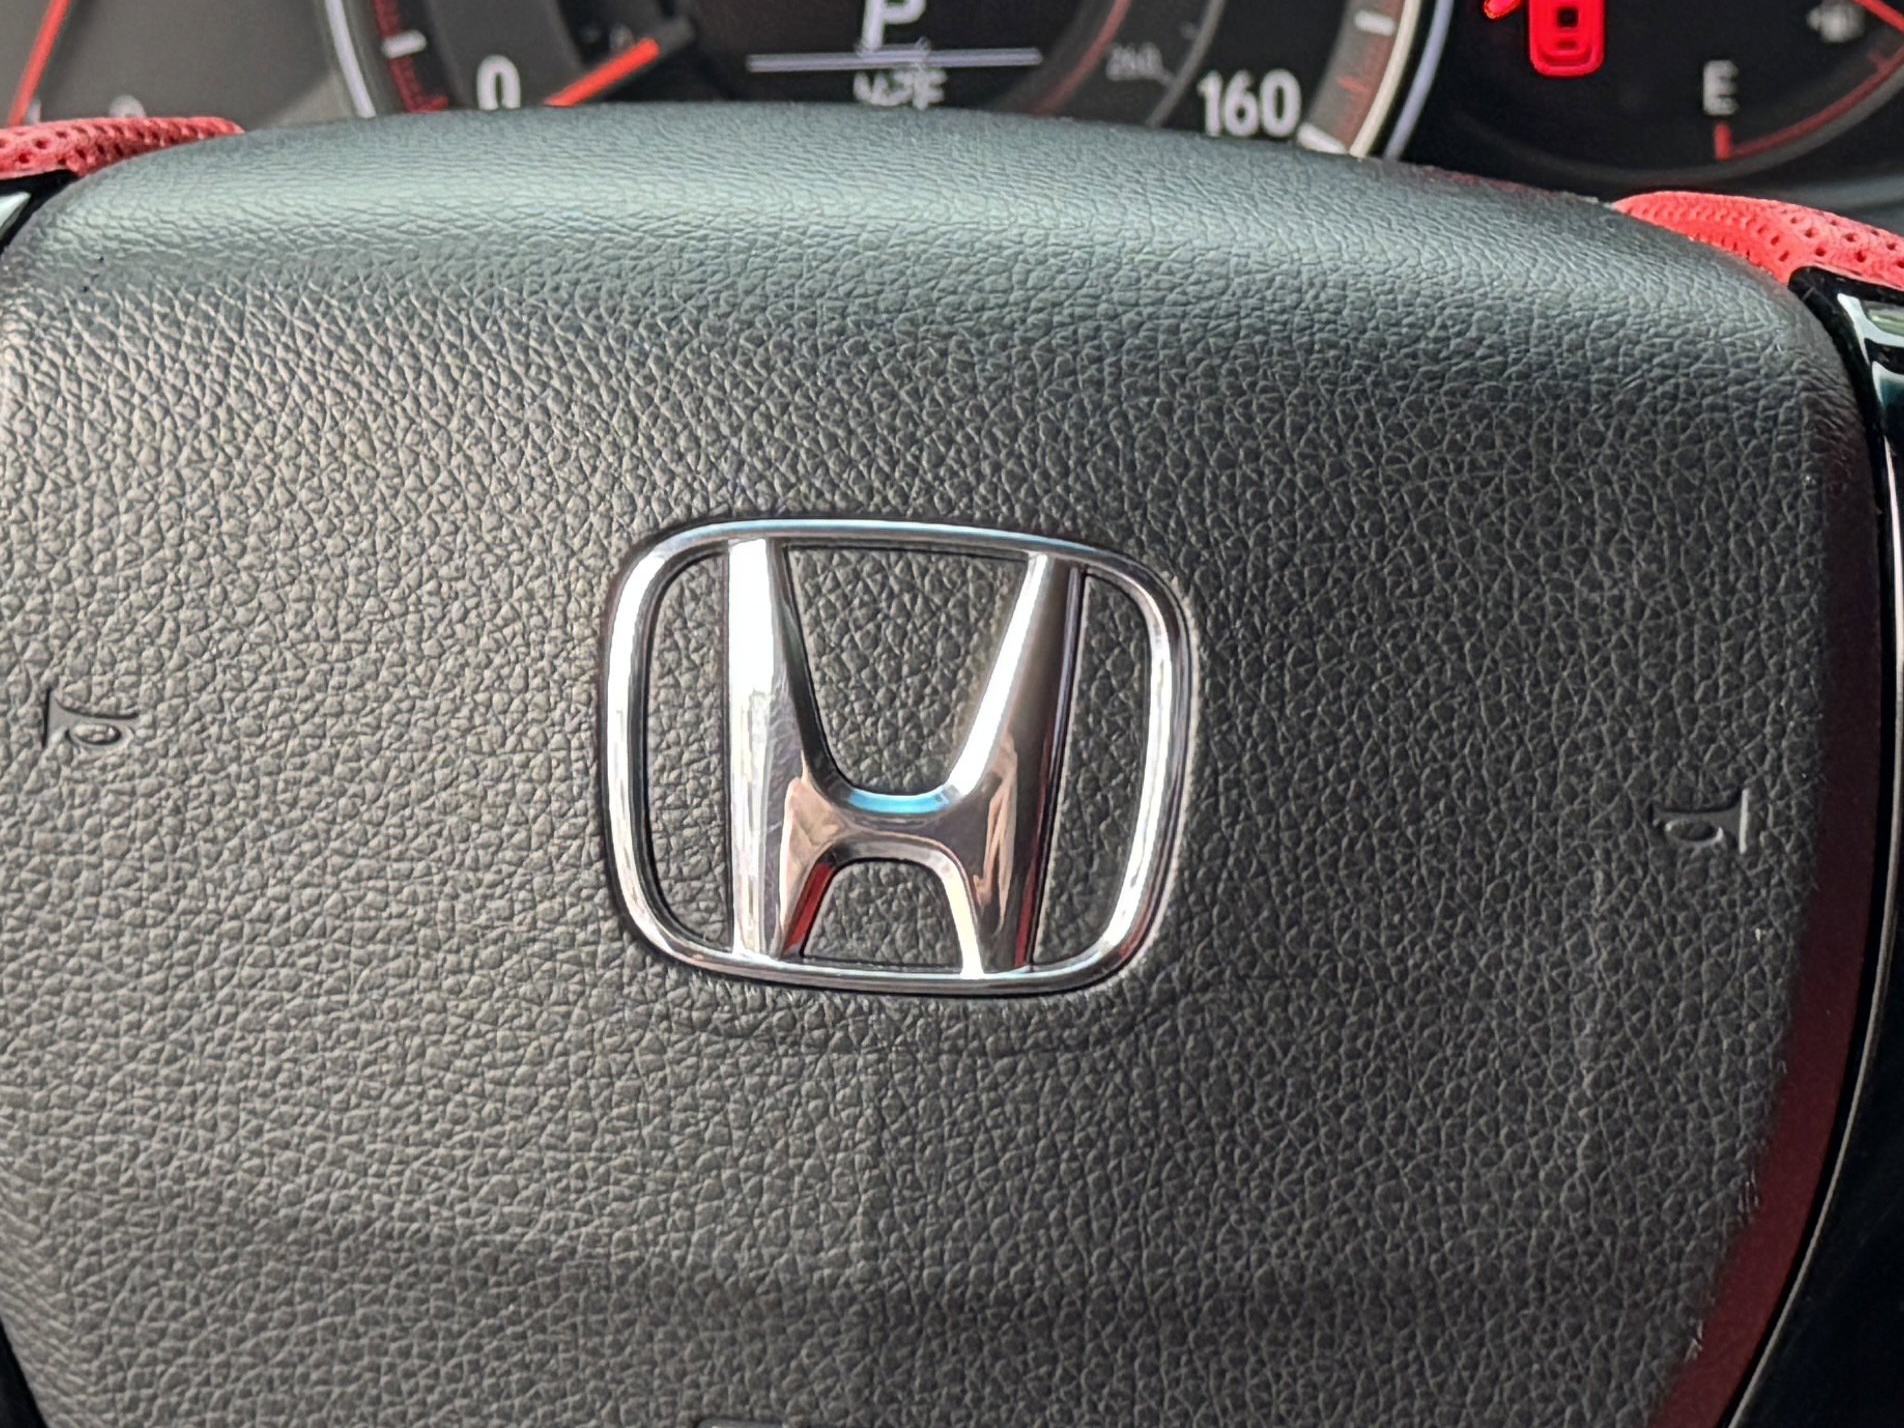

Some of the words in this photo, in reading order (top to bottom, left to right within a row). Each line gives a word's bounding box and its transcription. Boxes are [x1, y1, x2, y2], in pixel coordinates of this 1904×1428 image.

[476, 55, 522, 111] 0
[1199, 69, 1302, 138] 160
[1701, 60, 1739, 116] E
